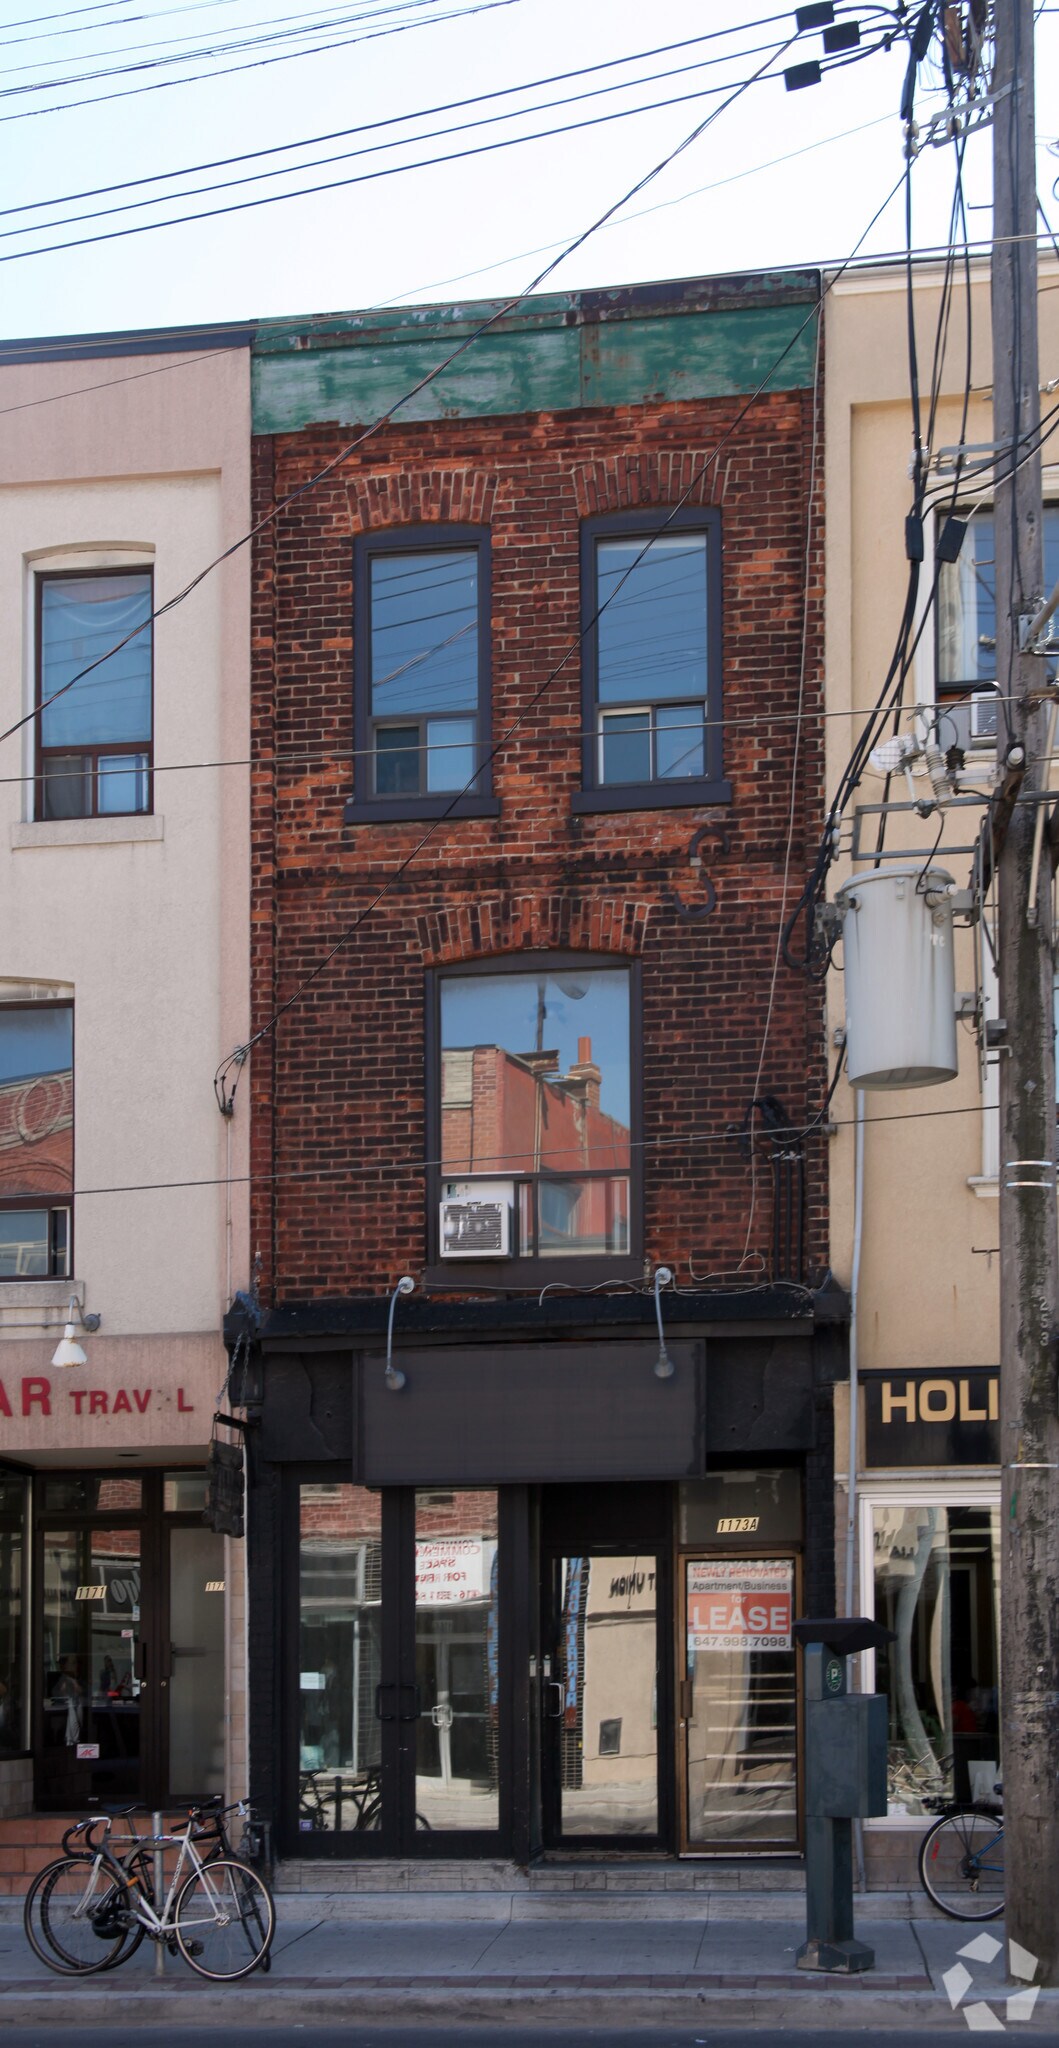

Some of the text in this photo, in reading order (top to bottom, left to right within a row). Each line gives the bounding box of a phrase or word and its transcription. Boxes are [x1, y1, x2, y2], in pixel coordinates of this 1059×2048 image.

[69, 1388, 194, 1415] TRAVL
[882, 1378, 999, 1424] HOLI
[719, 1518, 758, 1531] 1173A
[693, 1567, 788, 1578] NEWLY RENOVATED
[78, 1586, 106, 1599] 1171
[692, 1581, 788, 1592] Apartment/Business
[731, 1594, 748, 1603] for
[693, 1606, 788, 1631] LEASE
[694, 1637, 787, 1647] 647.998.7098
